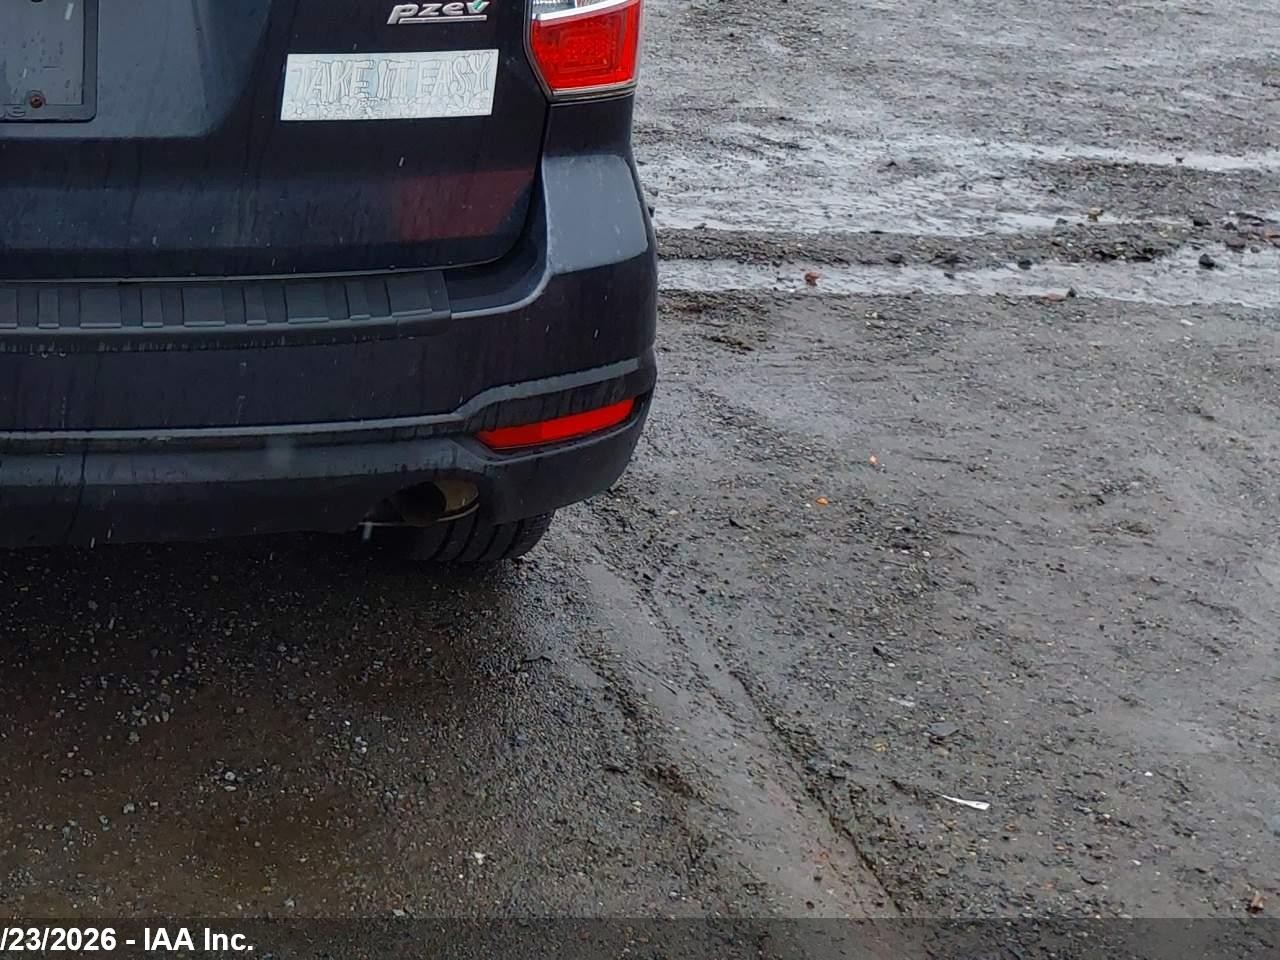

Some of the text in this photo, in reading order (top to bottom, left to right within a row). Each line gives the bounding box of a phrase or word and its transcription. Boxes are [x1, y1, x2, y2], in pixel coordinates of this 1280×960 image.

[290, 52, 494, 104] TAKE IT EASY
